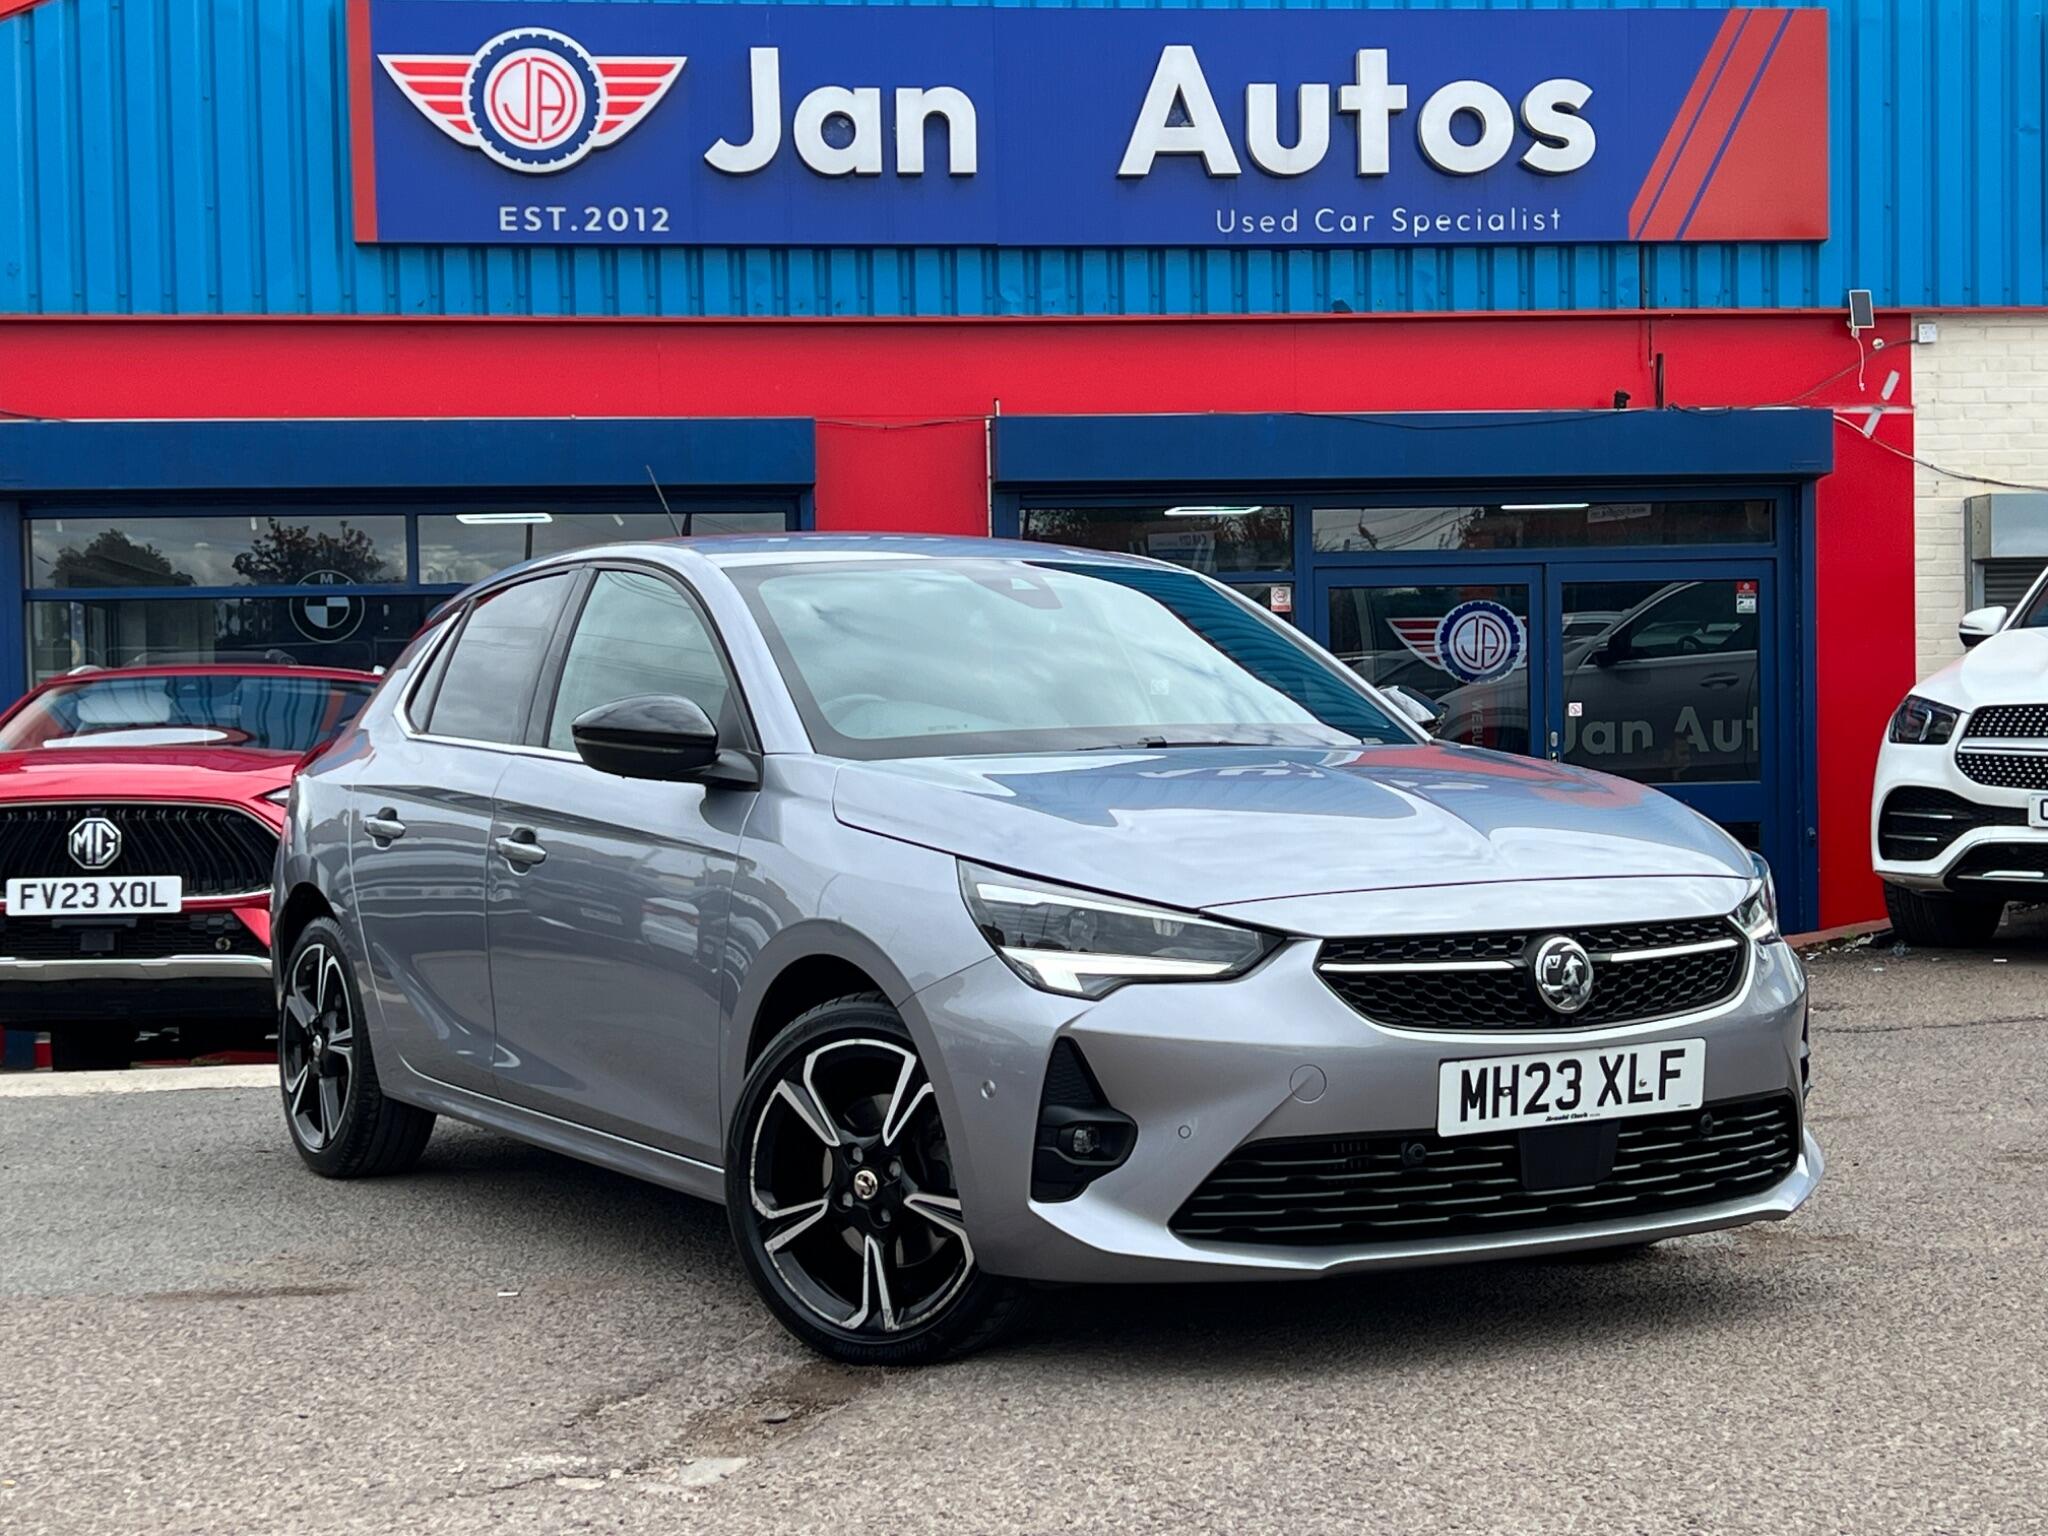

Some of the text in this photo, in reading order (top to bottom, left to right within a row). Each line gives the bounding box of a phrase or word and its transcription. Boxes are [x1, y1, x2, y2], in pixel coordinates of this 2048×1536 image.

[704, 45, 1597, 177] Jan Autos
[499, 206, 670, 232] EST.2012
[1215, 206, 1562, 238] Used Car Specialist
[1564, 708, 1654, 755] Jan
[72, 821, 117, 865] MG
[20, 880, 169, 910] FV23 XOL
[1459, 1047, 1687, 1123] MH23 XLF
